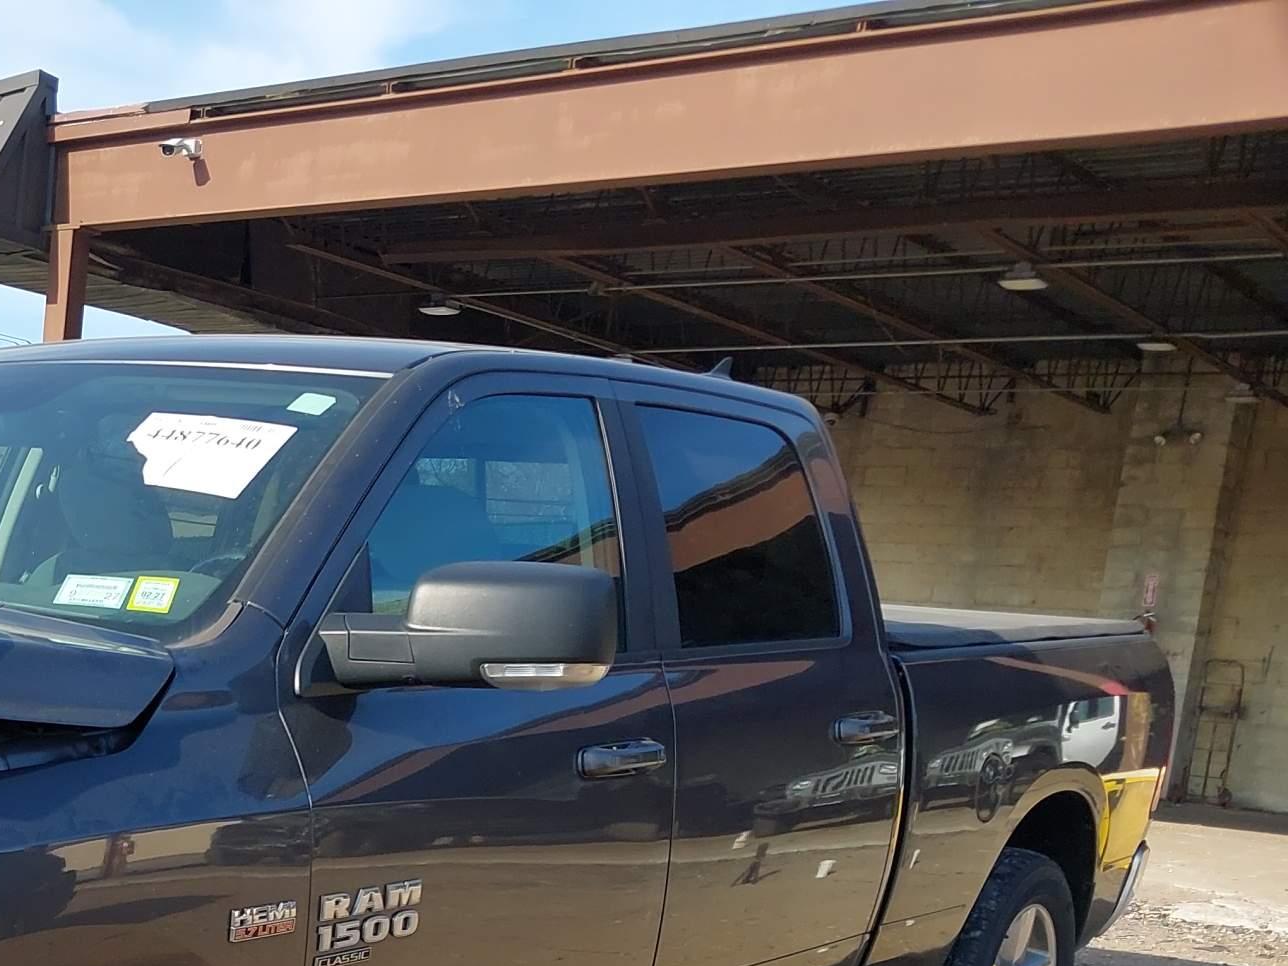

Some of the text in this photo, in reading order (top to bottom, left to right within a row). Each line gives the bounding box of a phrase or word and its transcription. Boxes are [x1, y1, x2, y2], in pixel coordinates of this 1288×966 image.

[147, 428, 262, 449] 44877640
[230, 901, 297, 928] HEMI
[319, 877, 423, 922] RAM
[316, 909, 420, 953] 1500
